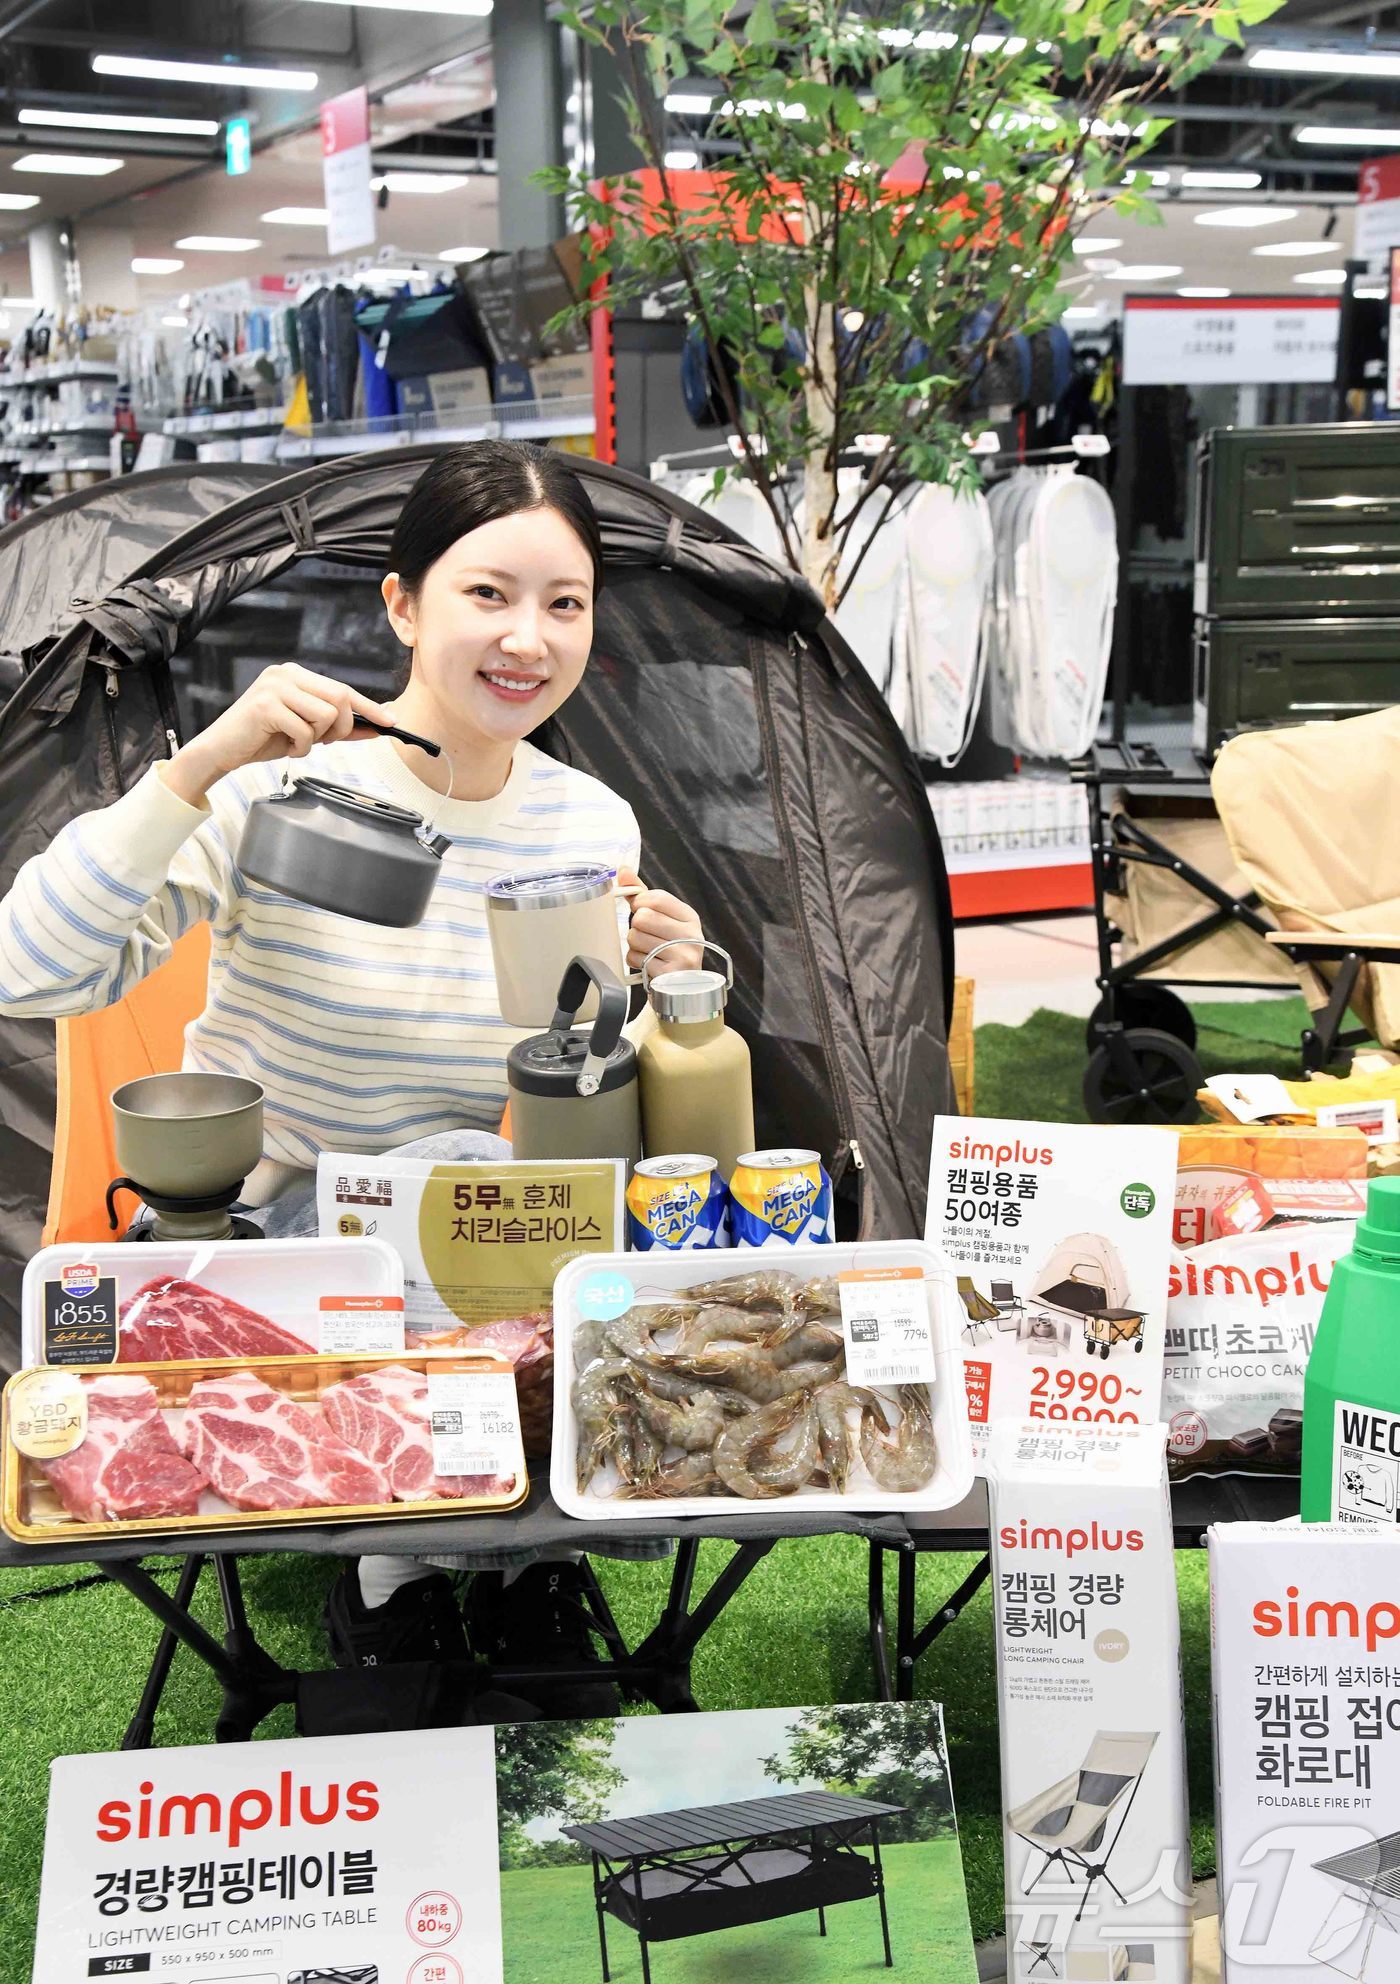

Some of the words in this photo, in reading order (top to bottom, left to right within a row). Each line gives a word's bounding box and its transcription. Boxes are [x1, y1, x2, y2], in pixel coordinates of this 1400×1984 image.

[949, 1136, 1053, 1167] simplus
[946, 1168, 1039, 1199] 캠핑용품
[523, 1183, 571, 1209] 훈제
[650, 1192, 670, 1206] SIZE
[763, 1178, 817, 1216] MEGA
[1124, 1195, 1151, 1212] 단독
[647, 1189, 702, 1224] MEGA
[770, 1198, 812, 1230] CAN
[944, 1198, 1023, 1228] 50여종
[450, 1216, 602, 1244] 치킨슬라이스
[654, 1209, 696, 1239] CAN
[943, 1225, 973, 1237] 나들이의
[942, 1239, 971, 1248] simplus
[973, 1240, 1011, 1252] 캠핑용품과
[1013, 1243, 1029, 1254] 함께
[950, 1249, 981, 1262] 나들이를
[983, 1252, 1022, 1265] 즐겨보세요
[67, 1278, 93, 1286] PRIME
[68, 1269, 93, 1277] USDA
[1168, 1252, 1337, 1307] simplu
[584, 1285, 625, 1304] 국산
[904, 1328, 928, 1341] 7796
[1164, 1366, 1202, 1380] PETIT
[1207, 1364, 1267, 1378] CHOCO
[1271, 1364, 1306, 1377] CAK
[1030, 1366, 1142, 1405] 2,990~
[30, 1403, 67, 1417] YBD
[17, 1415, 81, 1436] 황금돼지
[483, 1422, 514, 1434] 16182
[1021, 1425, 1141, 1438] simplus
[1016, 1437, 1063, 1449] 캠핑
[1075, 1439, 1122, 1452] 경량
[1015, 1450, 1086, 1462] 롱체어
[1343, 1449, 1363, 1462] BEFORE
[1338, 1511, 1378, 1523] REMOV
[1000, 1519, 1144, 1558] simplus
[1001, 1572, 1056, 1605] 캠핑
[1068, 1573, 1125, 1606] 경량
[1003, 1606, 1086, 1640] 롱체어
[1003, 1646, 1053, 1655] LIGHTWEIGHT
[1026, 1656, 1060, 1664] CAMPING
[1254, 1665, 1328, 1687] 간편하게
[1254, 1694, 1330, 1739] 캠핑
[1256, 1743, 1371, 1789] 화로대
[96, 1771, 380, 1848] simplus
[1257, 1796, 1321, 1808] FOLDABLE
[1324, 1797, 1350, 1808] FIRE
[1354, 1798, 1372, 1809] PIT
[93, 1849, 378, 1916] 경량캠핑테이블
[419, 1904, 449, 1917] 내하중
[88, 1921, 221, 1948] LIGHTWEIGHT
[227, 1911, 316, 1935] CAMPING
[322, 1907, 377, 1927] TABLE
[104, 1958, 134, 1972] SIZE
[161, 1954, 181, 1966] 550
[183, 1955, 192, 1964] x
[195, 1951, 216, 1962] 950
[218, 1952, 225, 1960] x
[229, 1948, 249, 1959] 500
[252, 1946, 274, 1957] mm
[423, 1967, 445, 1982] 간편
